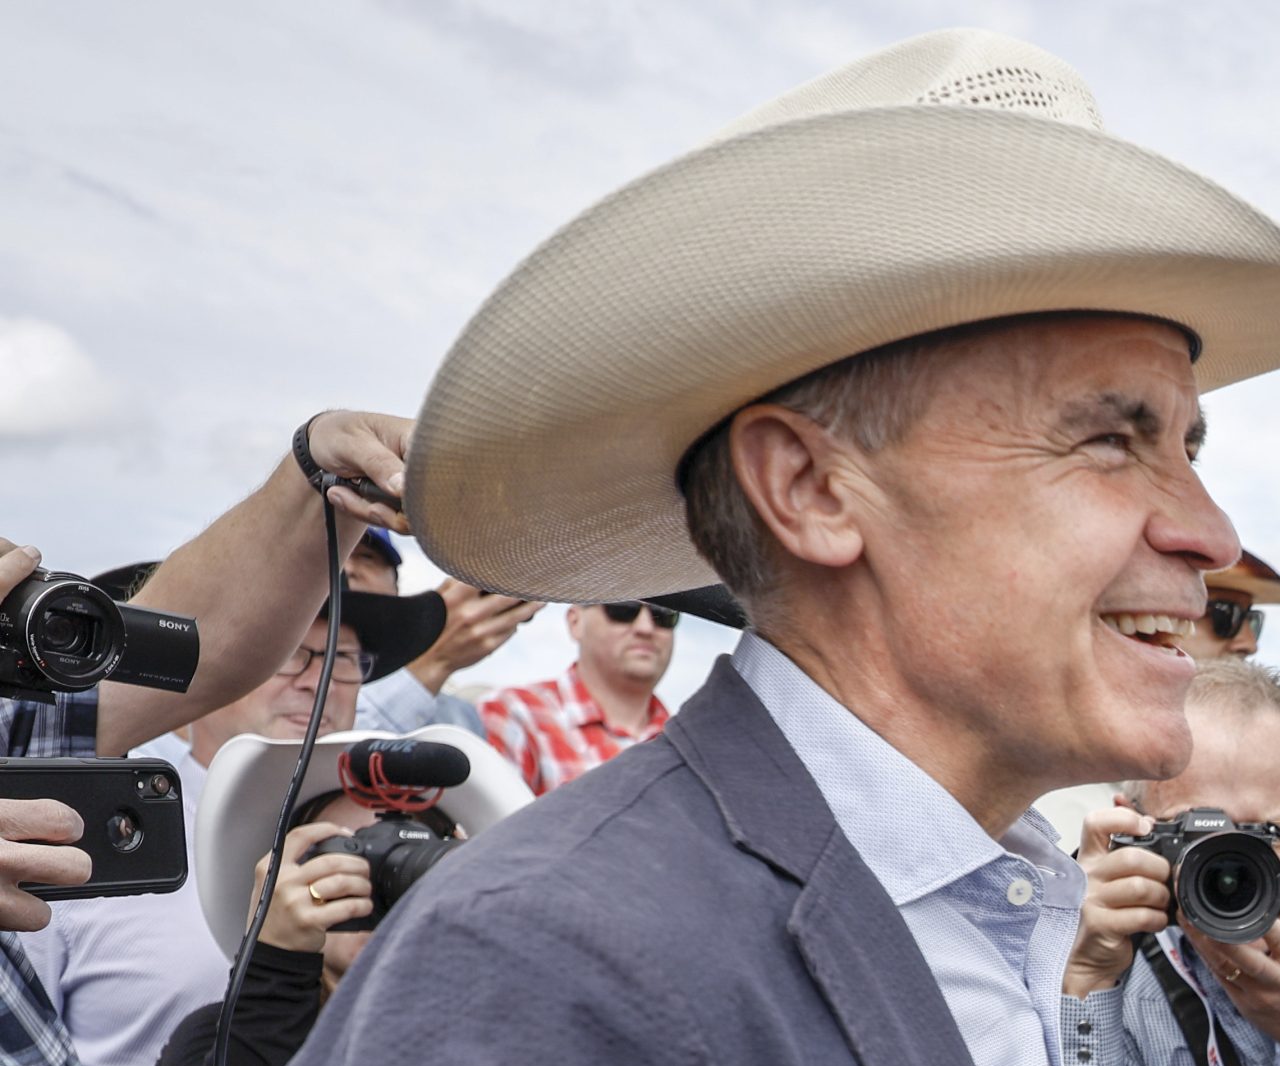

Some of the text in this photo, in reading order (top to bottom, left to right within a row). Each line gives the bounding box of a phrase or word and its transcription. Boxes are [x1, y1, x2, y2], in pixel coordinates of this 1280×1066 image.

[159, 619, 191, 632] SONY
[59, 657, 81, 665] SONY
[1194, 819, 1226, 827] SONY
[399, 829, 430, 840] Canon
